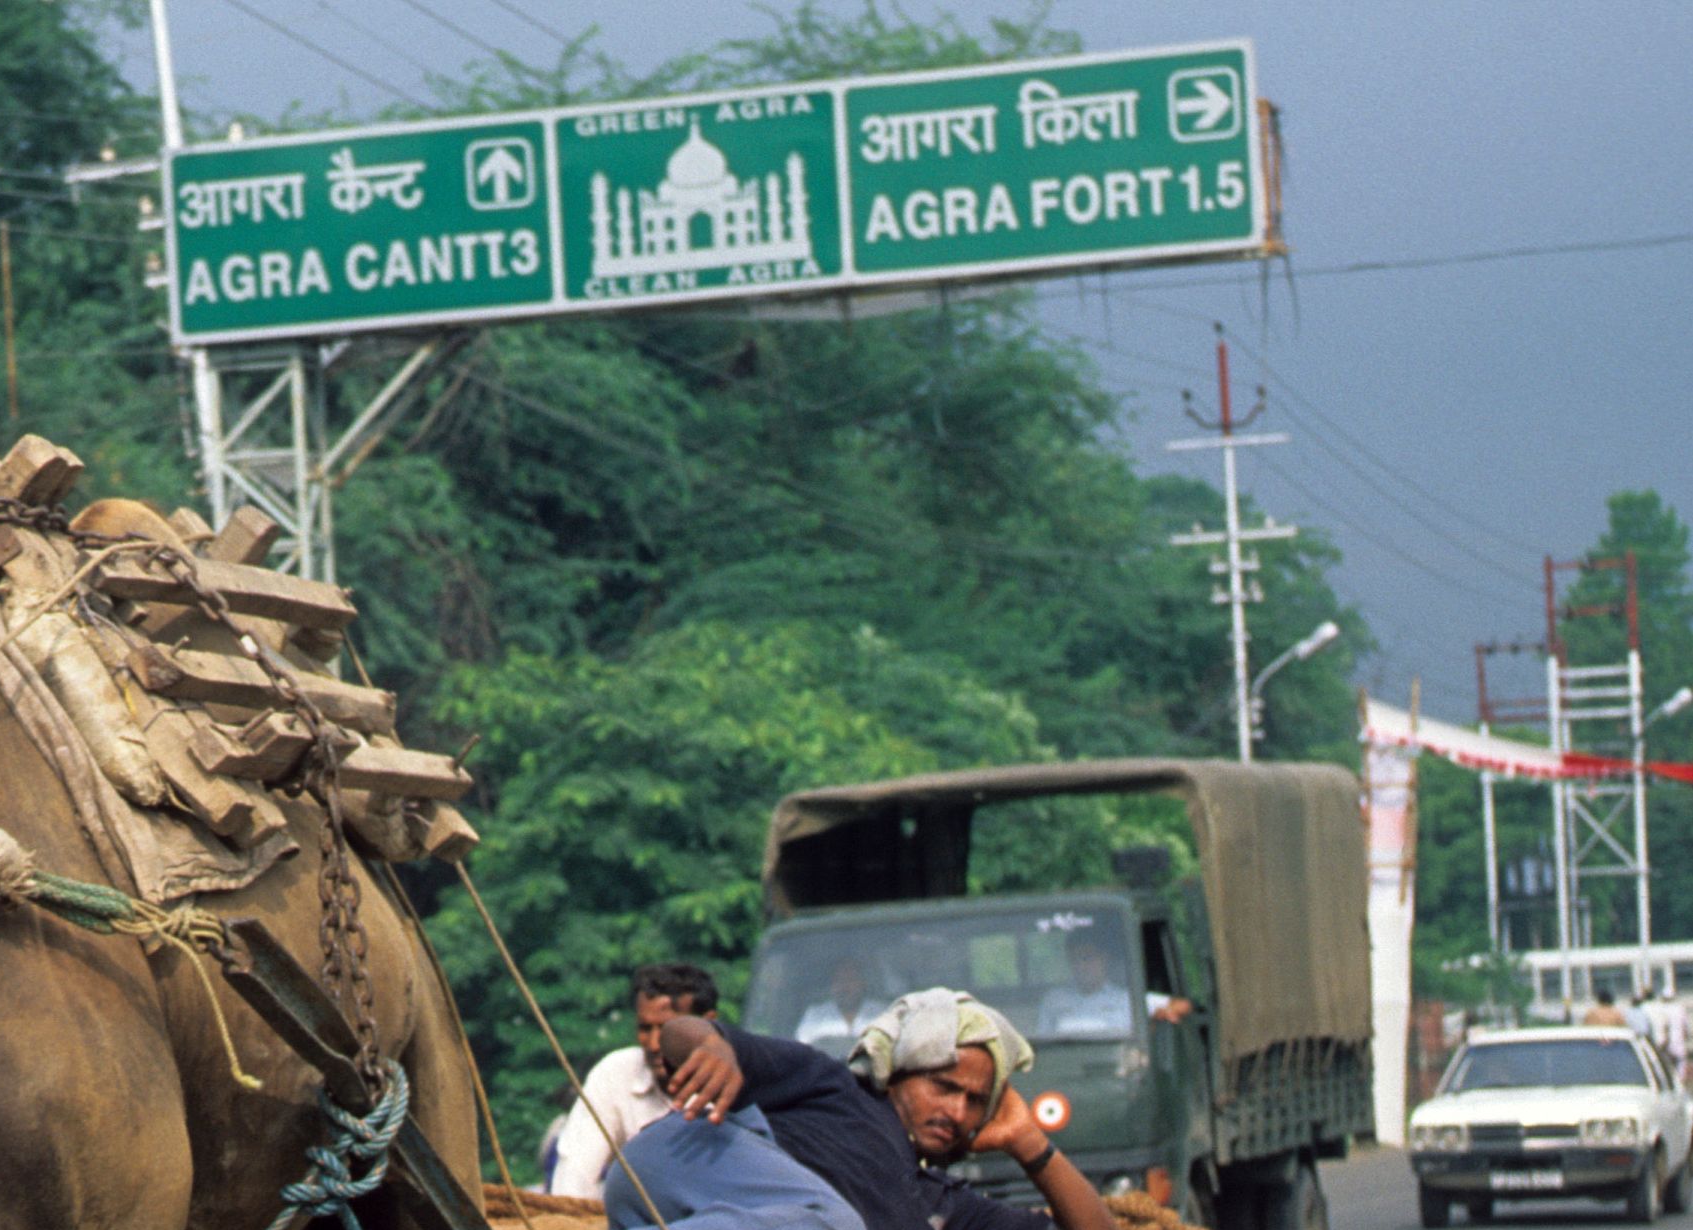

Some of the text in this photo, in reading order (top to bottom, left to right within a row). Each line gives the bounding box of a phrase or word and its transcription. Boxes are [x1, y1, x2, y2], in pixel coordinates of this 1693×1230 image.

[575, 94, 813, 137] GREEN AGRA
[860, 79, 1140, 163] आगरा किला
[179, 172, 305, 229] आगरा
[865, 160, 1245, 243] AGRA FORT 1.5
[185, 247, 332, 306] AGRA
[510, 228, 540, 275] 3
[583, 258, 821, 300] CLEAN AGRA
